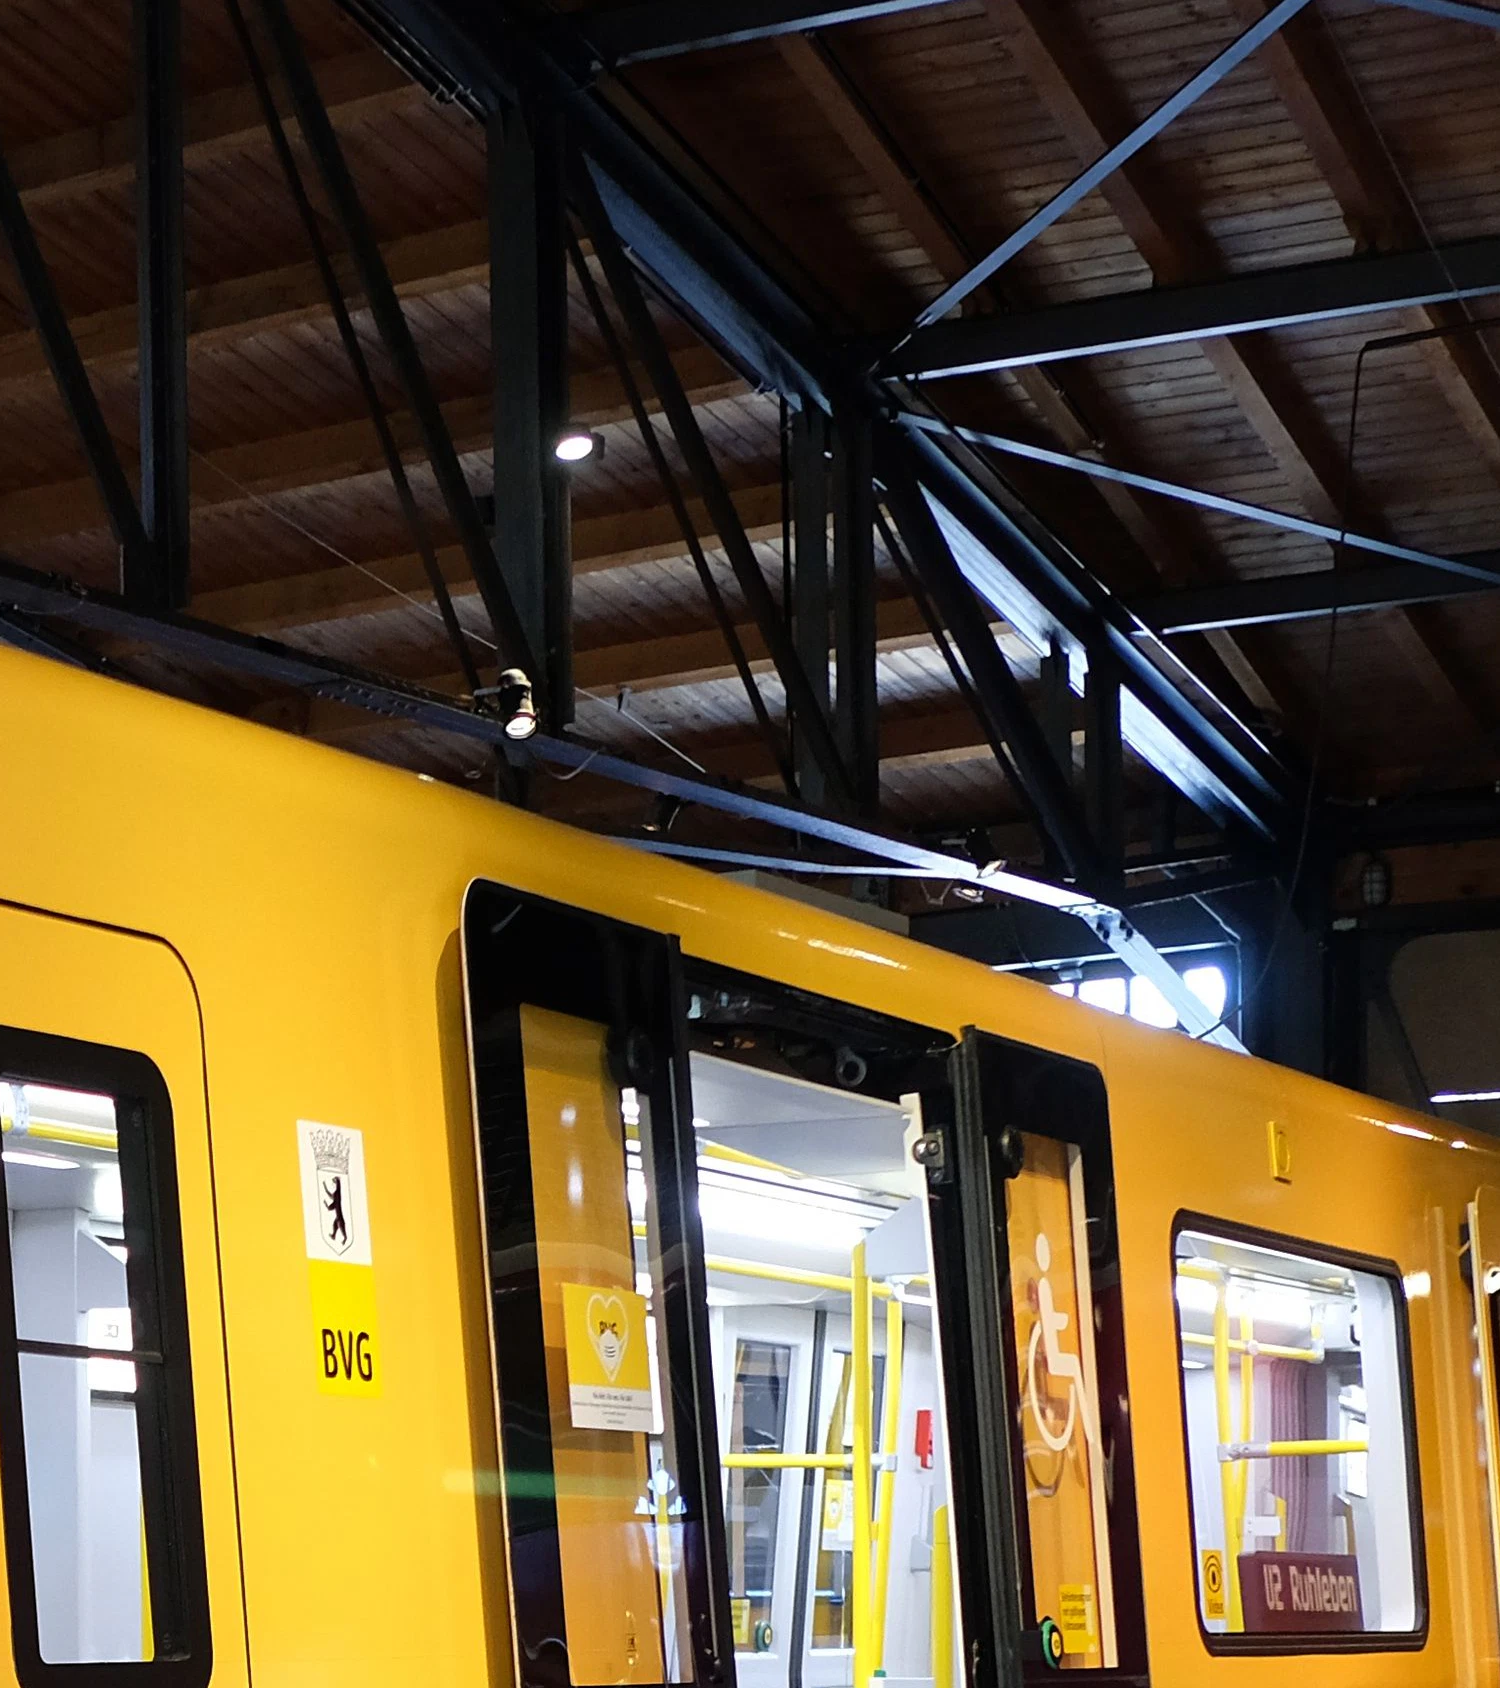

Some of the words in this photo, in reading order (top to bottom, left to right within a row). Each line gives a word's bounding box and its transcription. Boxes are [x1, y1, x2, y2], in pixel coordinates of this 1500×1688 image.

[322, 1328, 373, 1382] BVG
[1262, 1563, 1286, 1612] U2
[1289, 1565, 1359, 1613] Ruhleben
